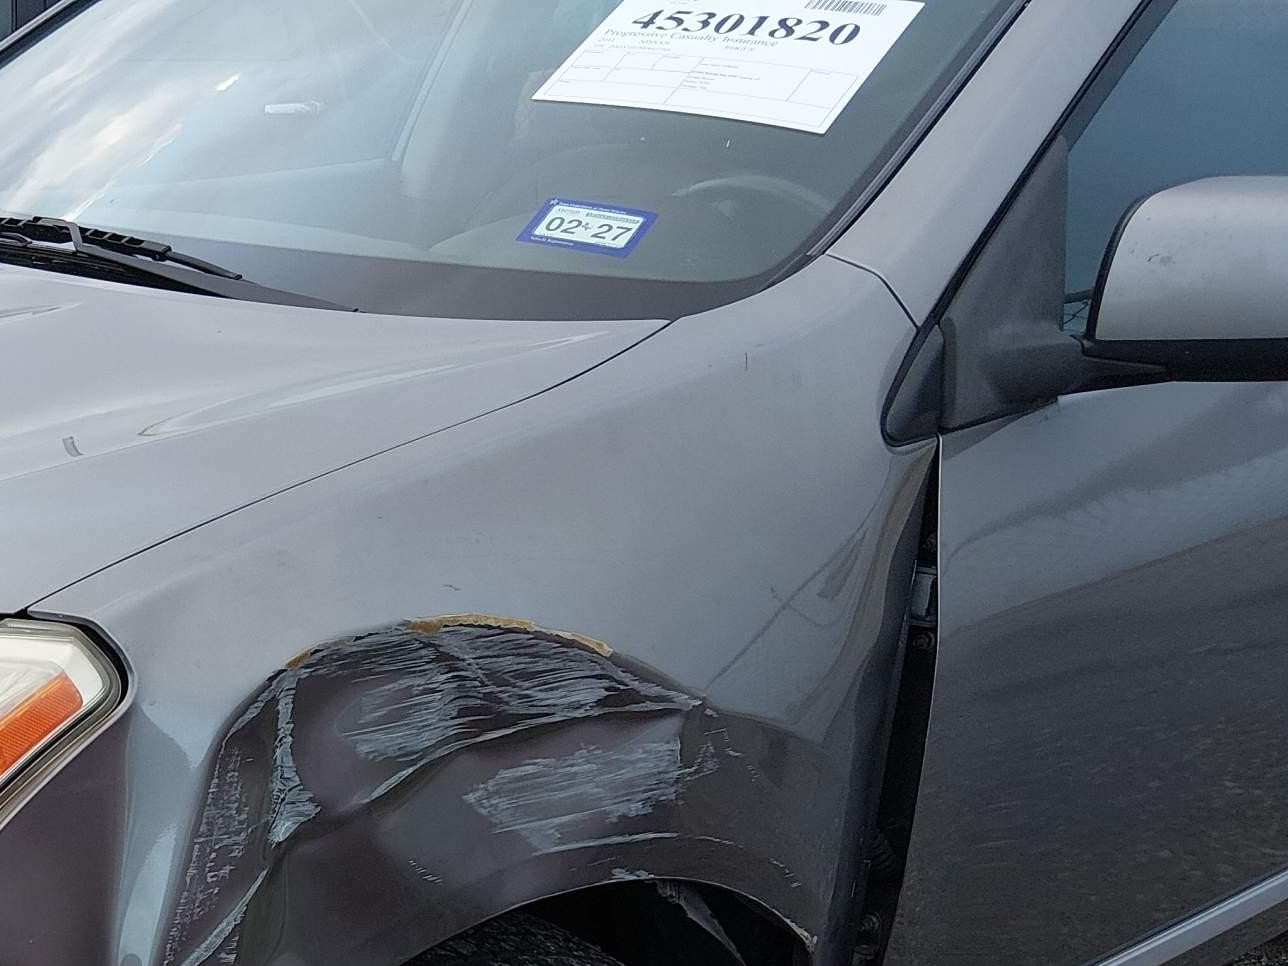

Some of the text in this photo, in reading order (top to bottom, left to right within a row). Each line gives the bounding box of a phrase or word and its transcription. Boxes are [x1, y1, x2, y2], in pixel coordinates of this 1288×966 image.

[631, 9, 861, 46] 45301820
[670, 32, 719, 42] Casualty
[721, 36, 779, 47] Insurance
[545, 216, 583, 235] 02
[590, 223, 633, 241] 27
